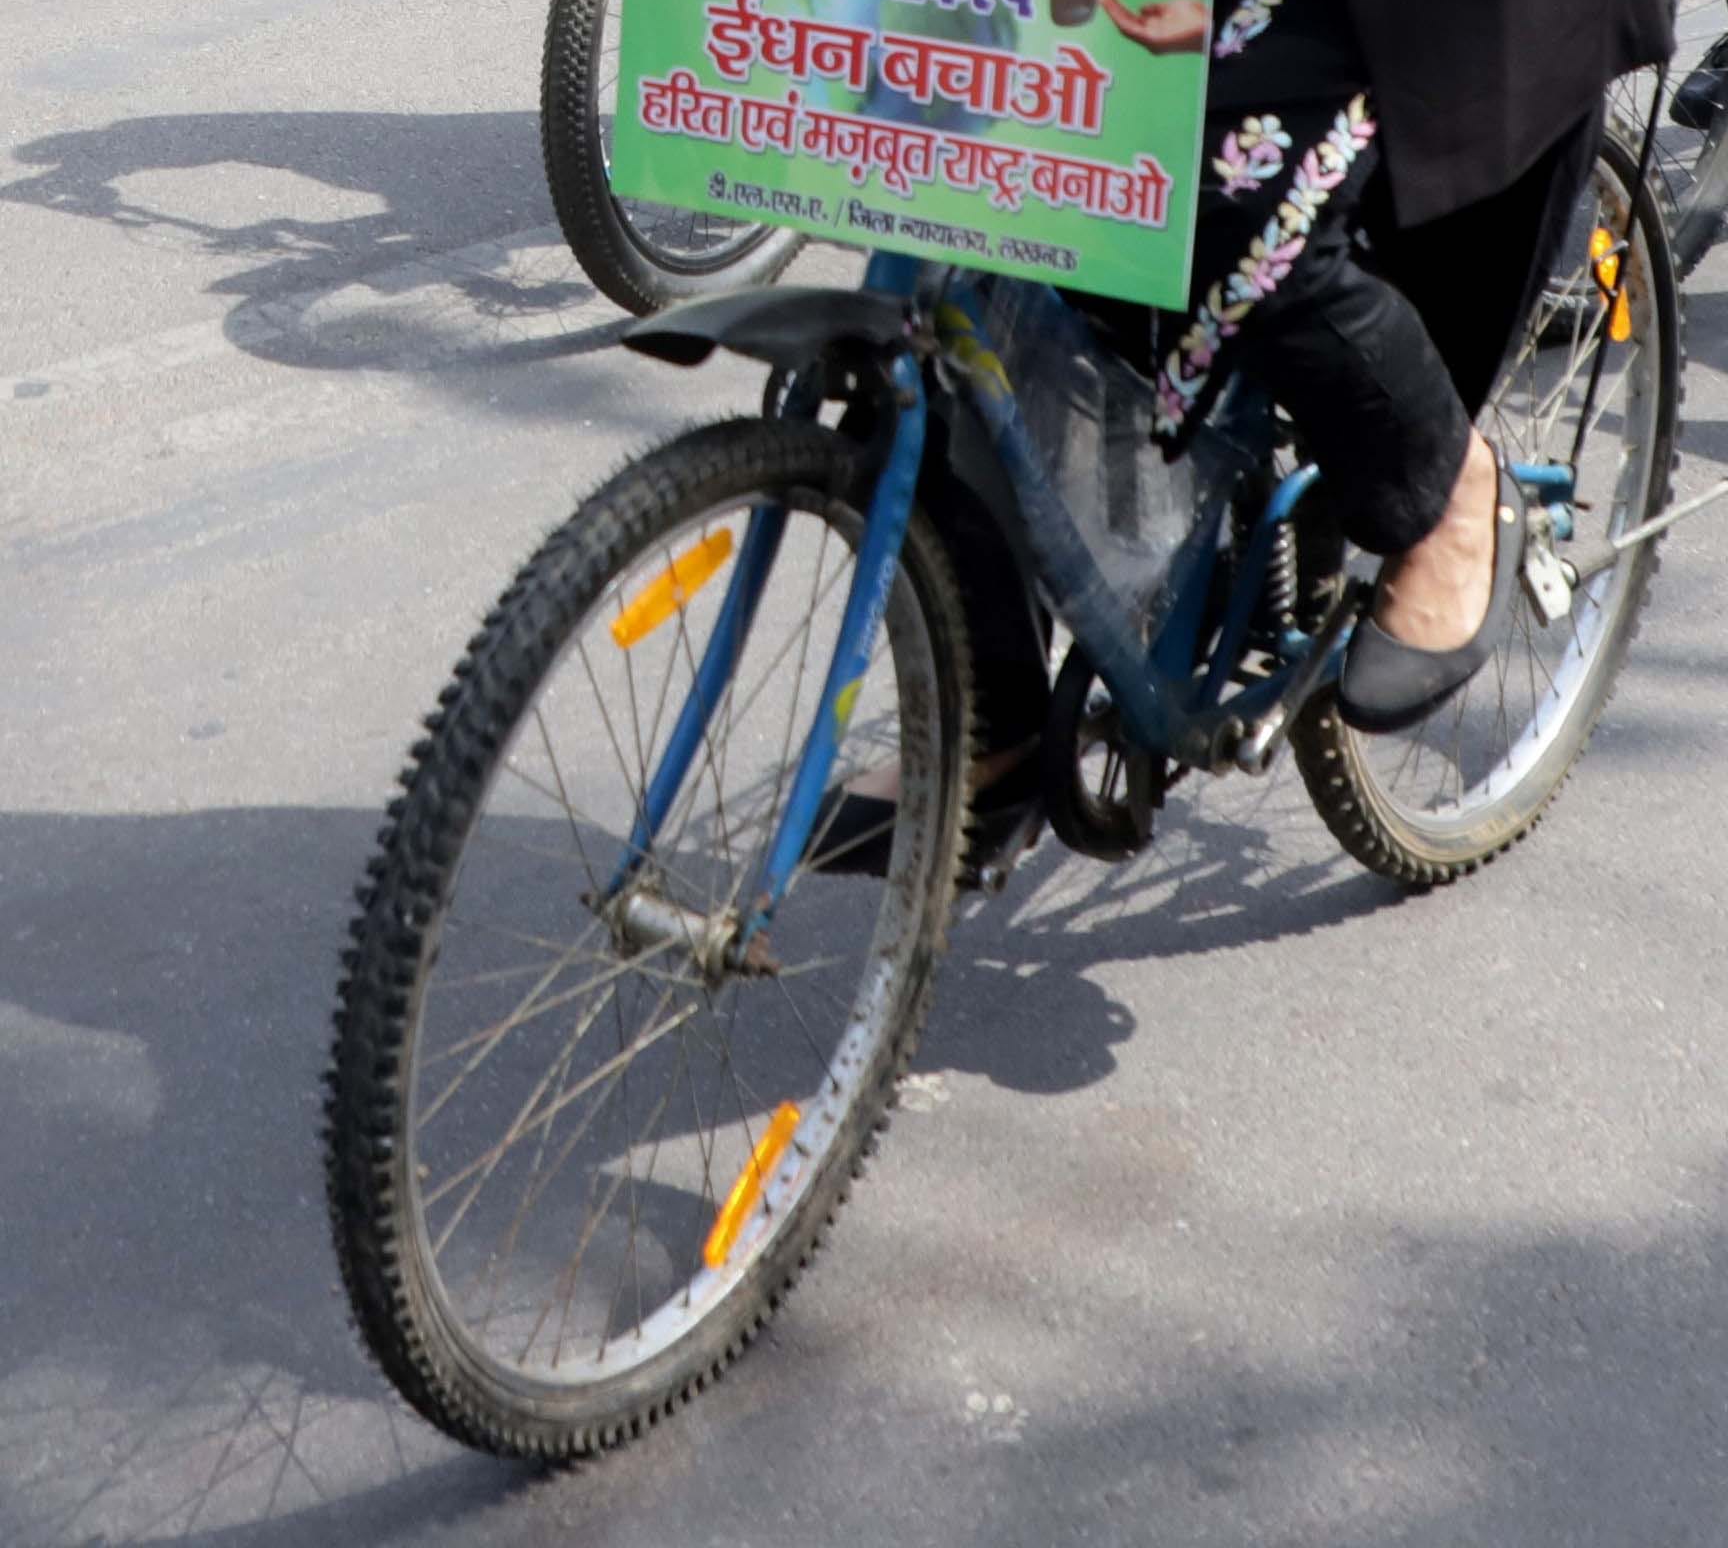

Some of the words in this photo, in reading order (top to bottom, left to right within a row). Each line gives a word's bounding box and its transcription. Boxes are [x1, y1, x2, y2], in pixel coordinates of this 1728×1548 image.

[883, 36, 1110, 132] बचाओ
[640, 71, 731, 137] हरित
[740, 91, 798, 150] एवं
[803, 112, 937, 195] मज़बूत
[943, 134, 1027, 206] राष्ट्र
[1030, 152, 1171, 225] बनाओ
[847, 201, 896, 236] जिला
[998, 238, 1079, 270] लखनऊ
